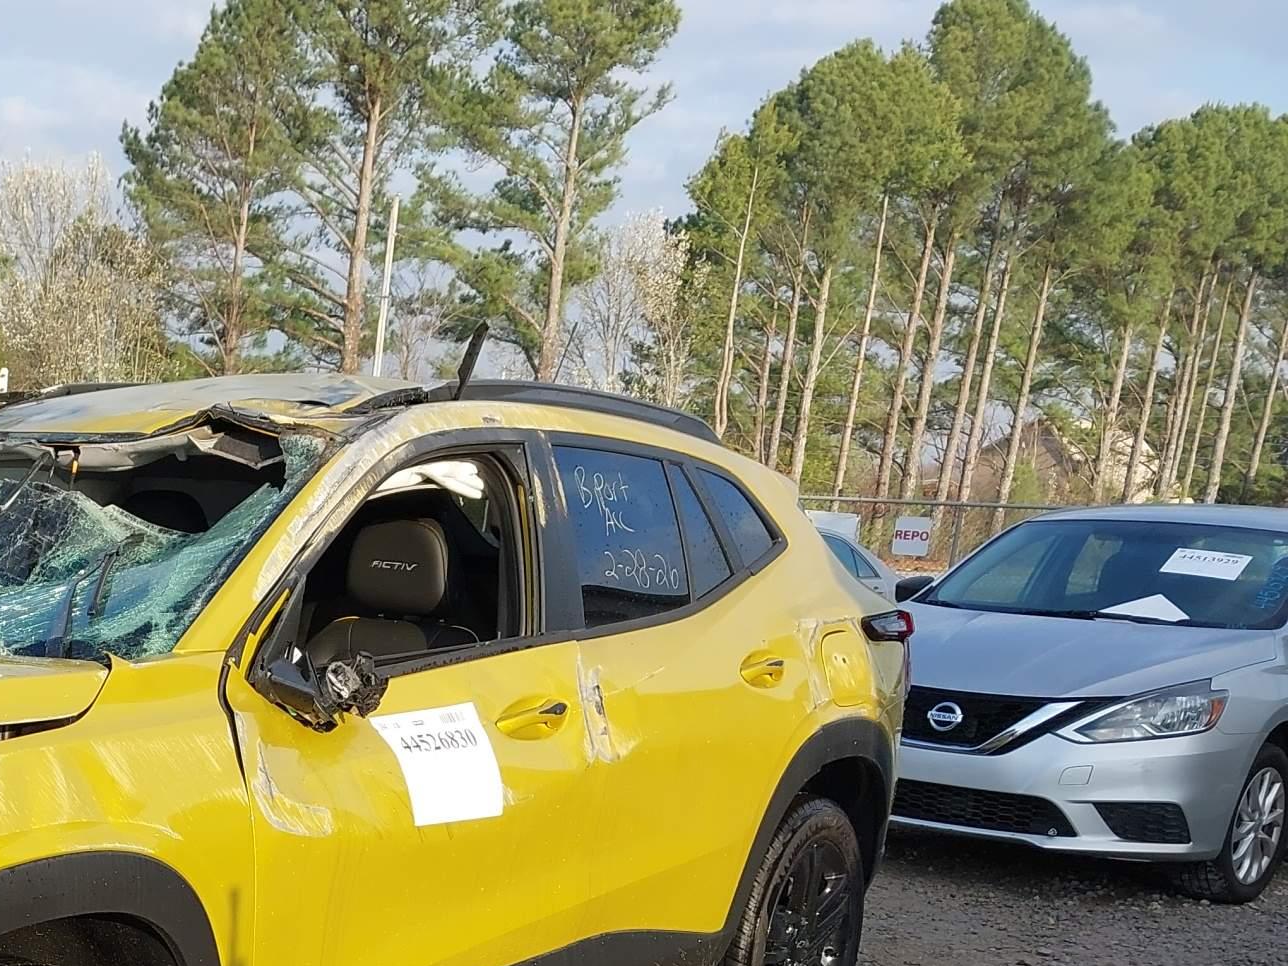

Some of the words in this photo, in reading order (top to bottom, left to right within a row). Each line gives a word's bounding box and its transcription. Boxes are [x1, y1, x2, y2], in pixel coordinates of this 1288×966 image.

[895, 529, 930, 541] REPO
[372, 560, 419, 571] ACTIV
[929, 711, 960, 721] NISSAN
[400, 728, 478, 753] 44526830
